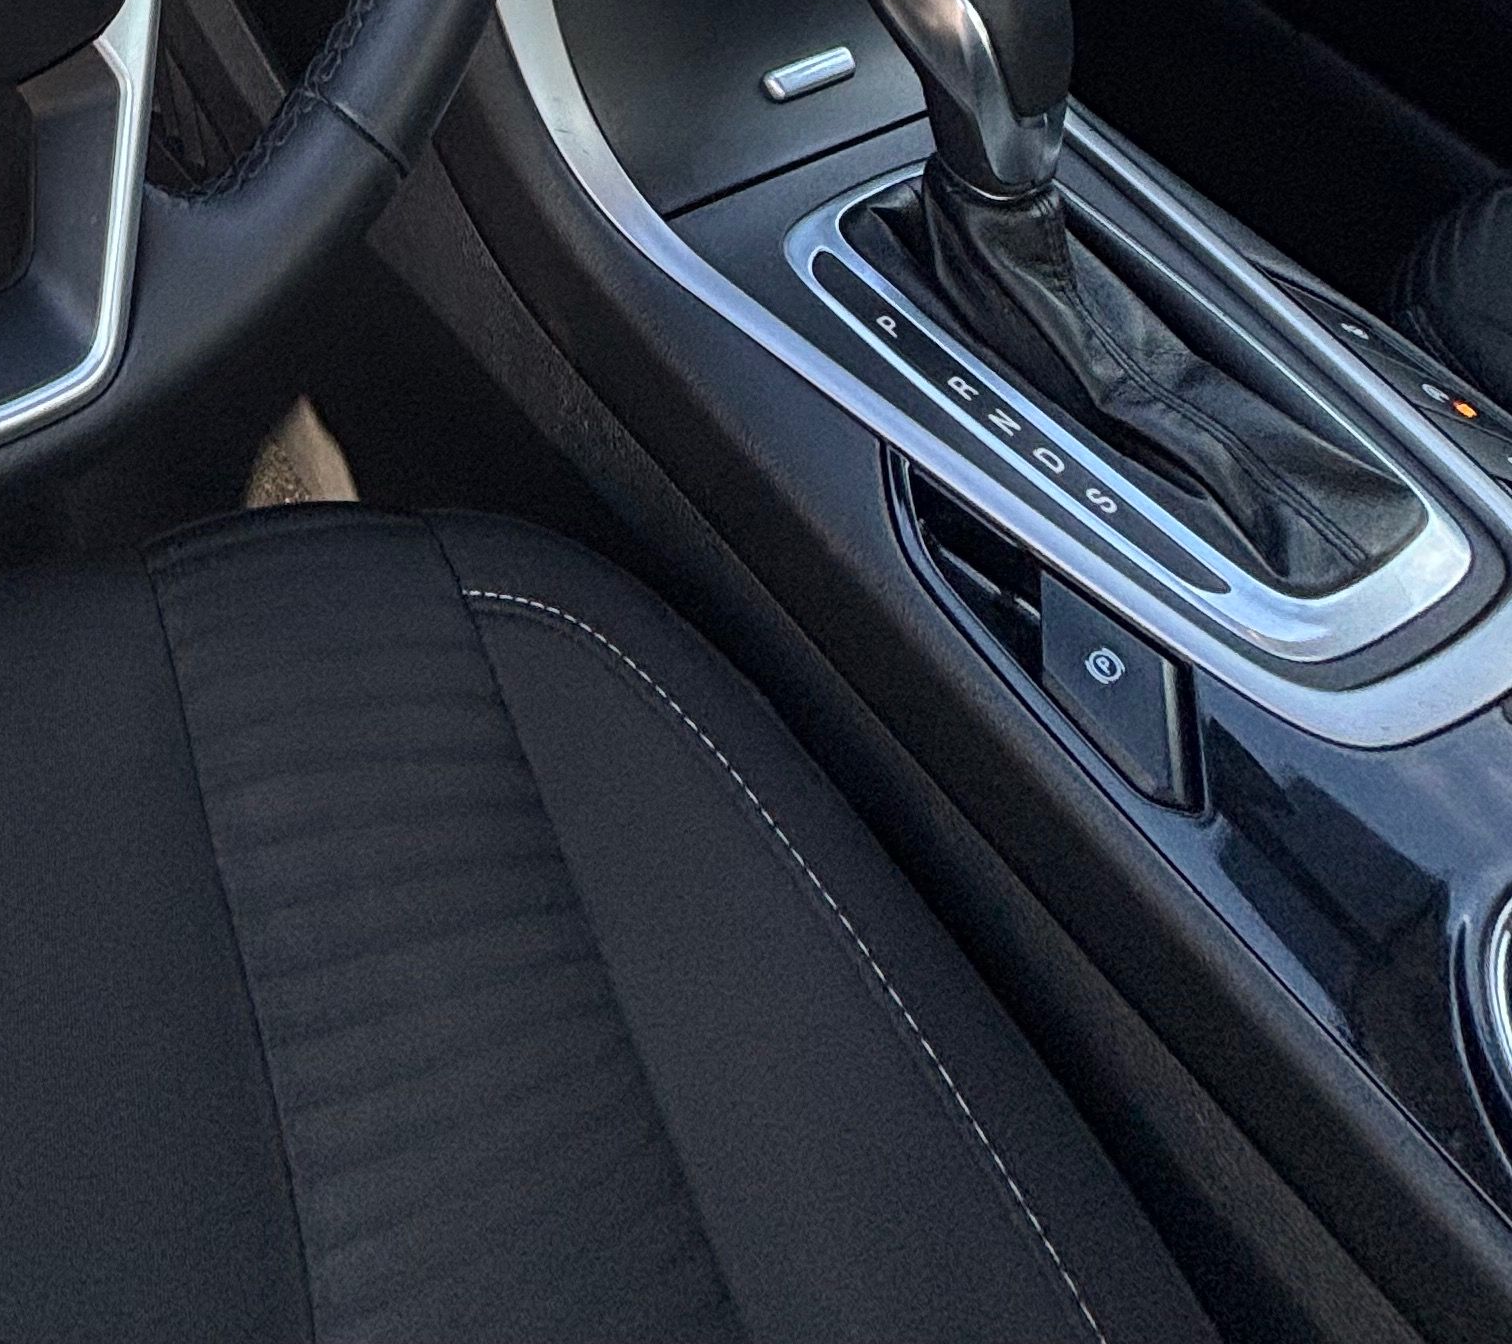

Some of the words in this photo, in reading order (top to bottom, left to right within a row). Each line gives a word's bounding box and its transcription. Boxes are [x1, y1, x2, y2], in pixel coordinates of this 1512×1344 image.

[875, 315, 899, 340] P
[946, 375, 981, 402] R
[987, 408, 1023, 438] N
[1032, 446, 1067, 475] D
[1084, 486, 1119, 515] S
